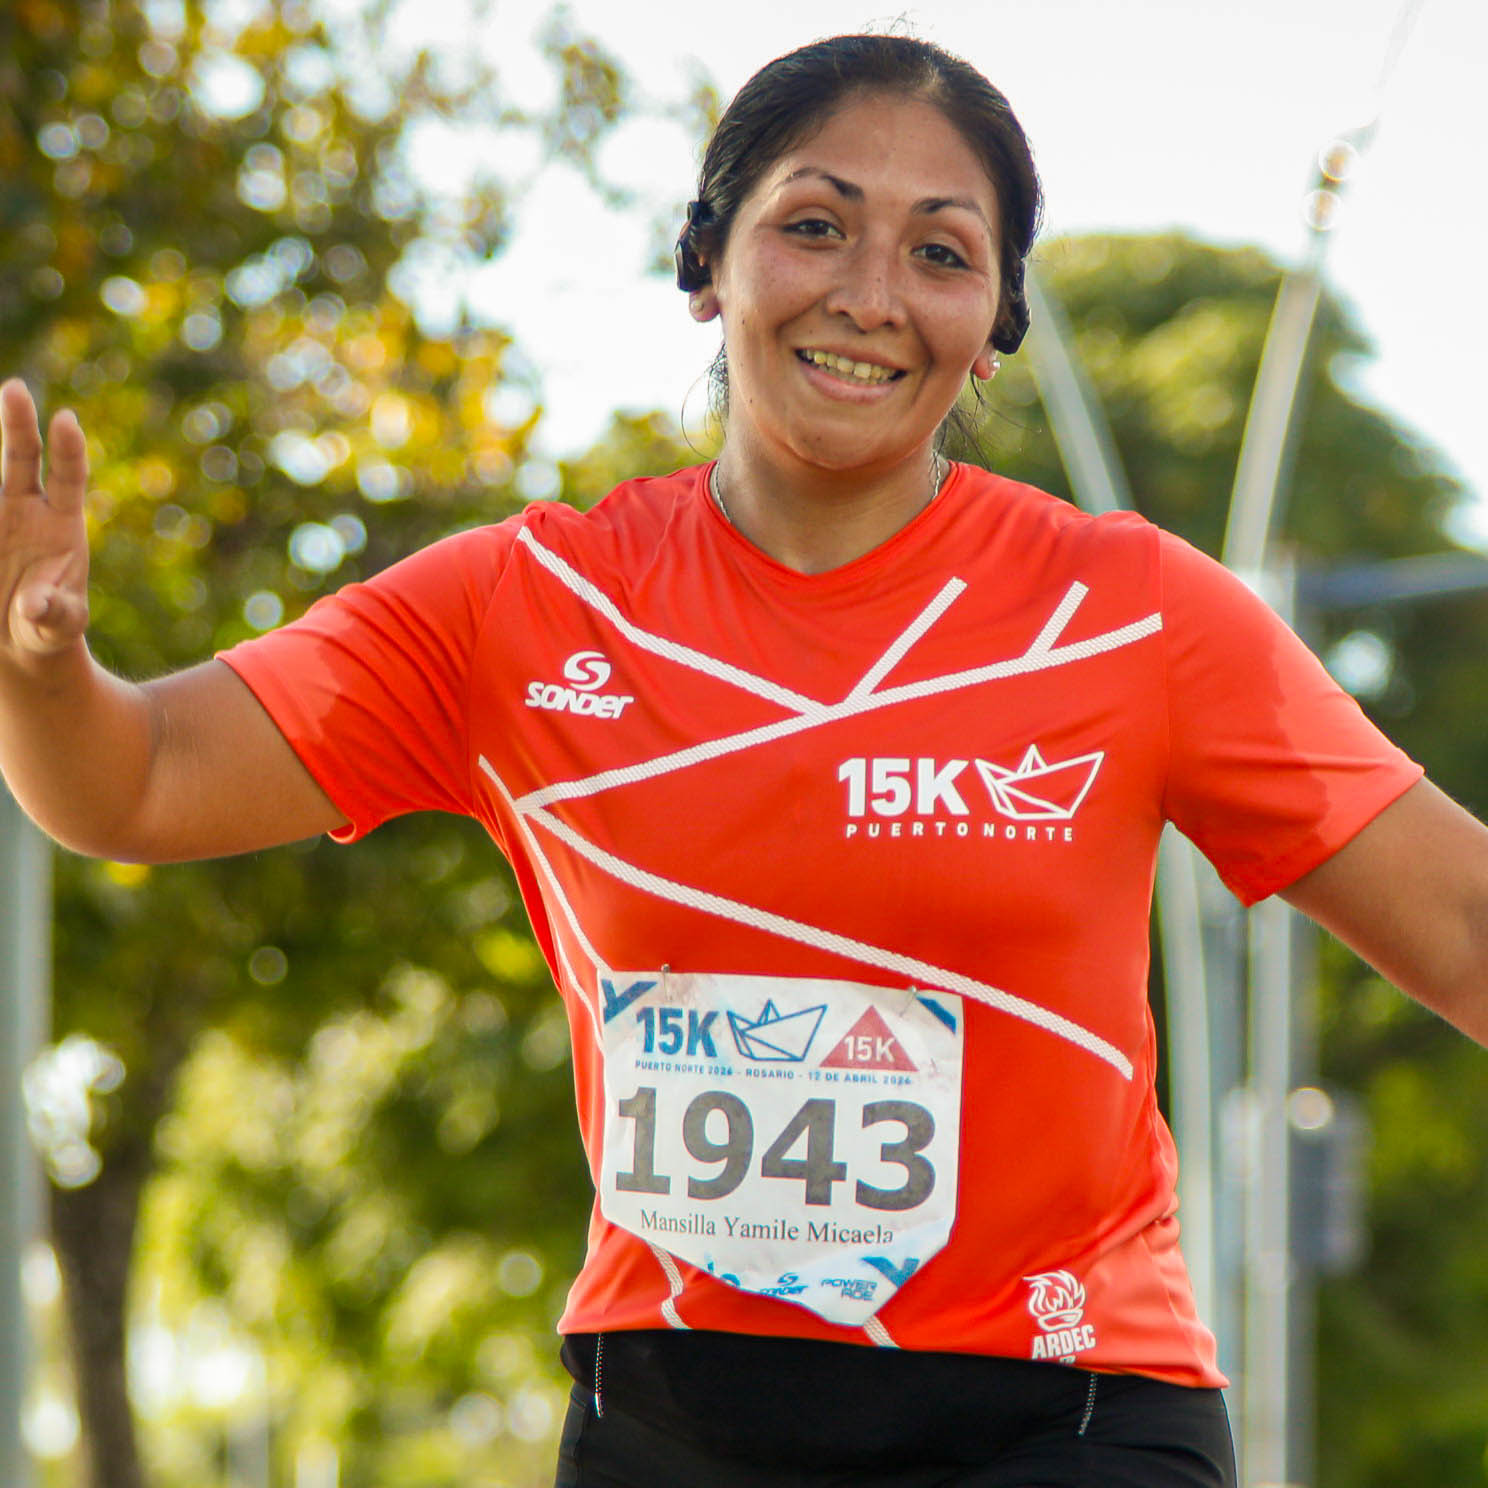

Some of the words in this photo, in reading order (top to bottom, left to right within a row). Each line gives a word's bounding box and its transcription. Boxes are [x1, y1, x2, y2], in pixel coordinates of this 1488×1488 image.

[838, 757, 970, 817] 15K
[846, 822, 969, 838] PUERTO
[983, 823, 1073, 842] NORTE
[636, 1007, 719, 1058] 15K
[844, 1035, 895, 1063] 15K
[635, 1059, 672, 1072] PUERTO
[674, 1062, 705, 1074] NORTE
[745, 1067, 795, 1080] ROSARIO
[825, 1072, 839, 1082] DE
[844, 1073, 879, 1084] ABRIL
[615, 1086, 937, 1212] 1943
[640, 1208, 716, 1236] Mansilla
[724, 1215, 800, 1241] Yamile
[807, 1219, 894, 1244] Micaela
[821, 1278, 877, 1290] POWER
[1032, 1324, 1097, 1360] ARDEC
